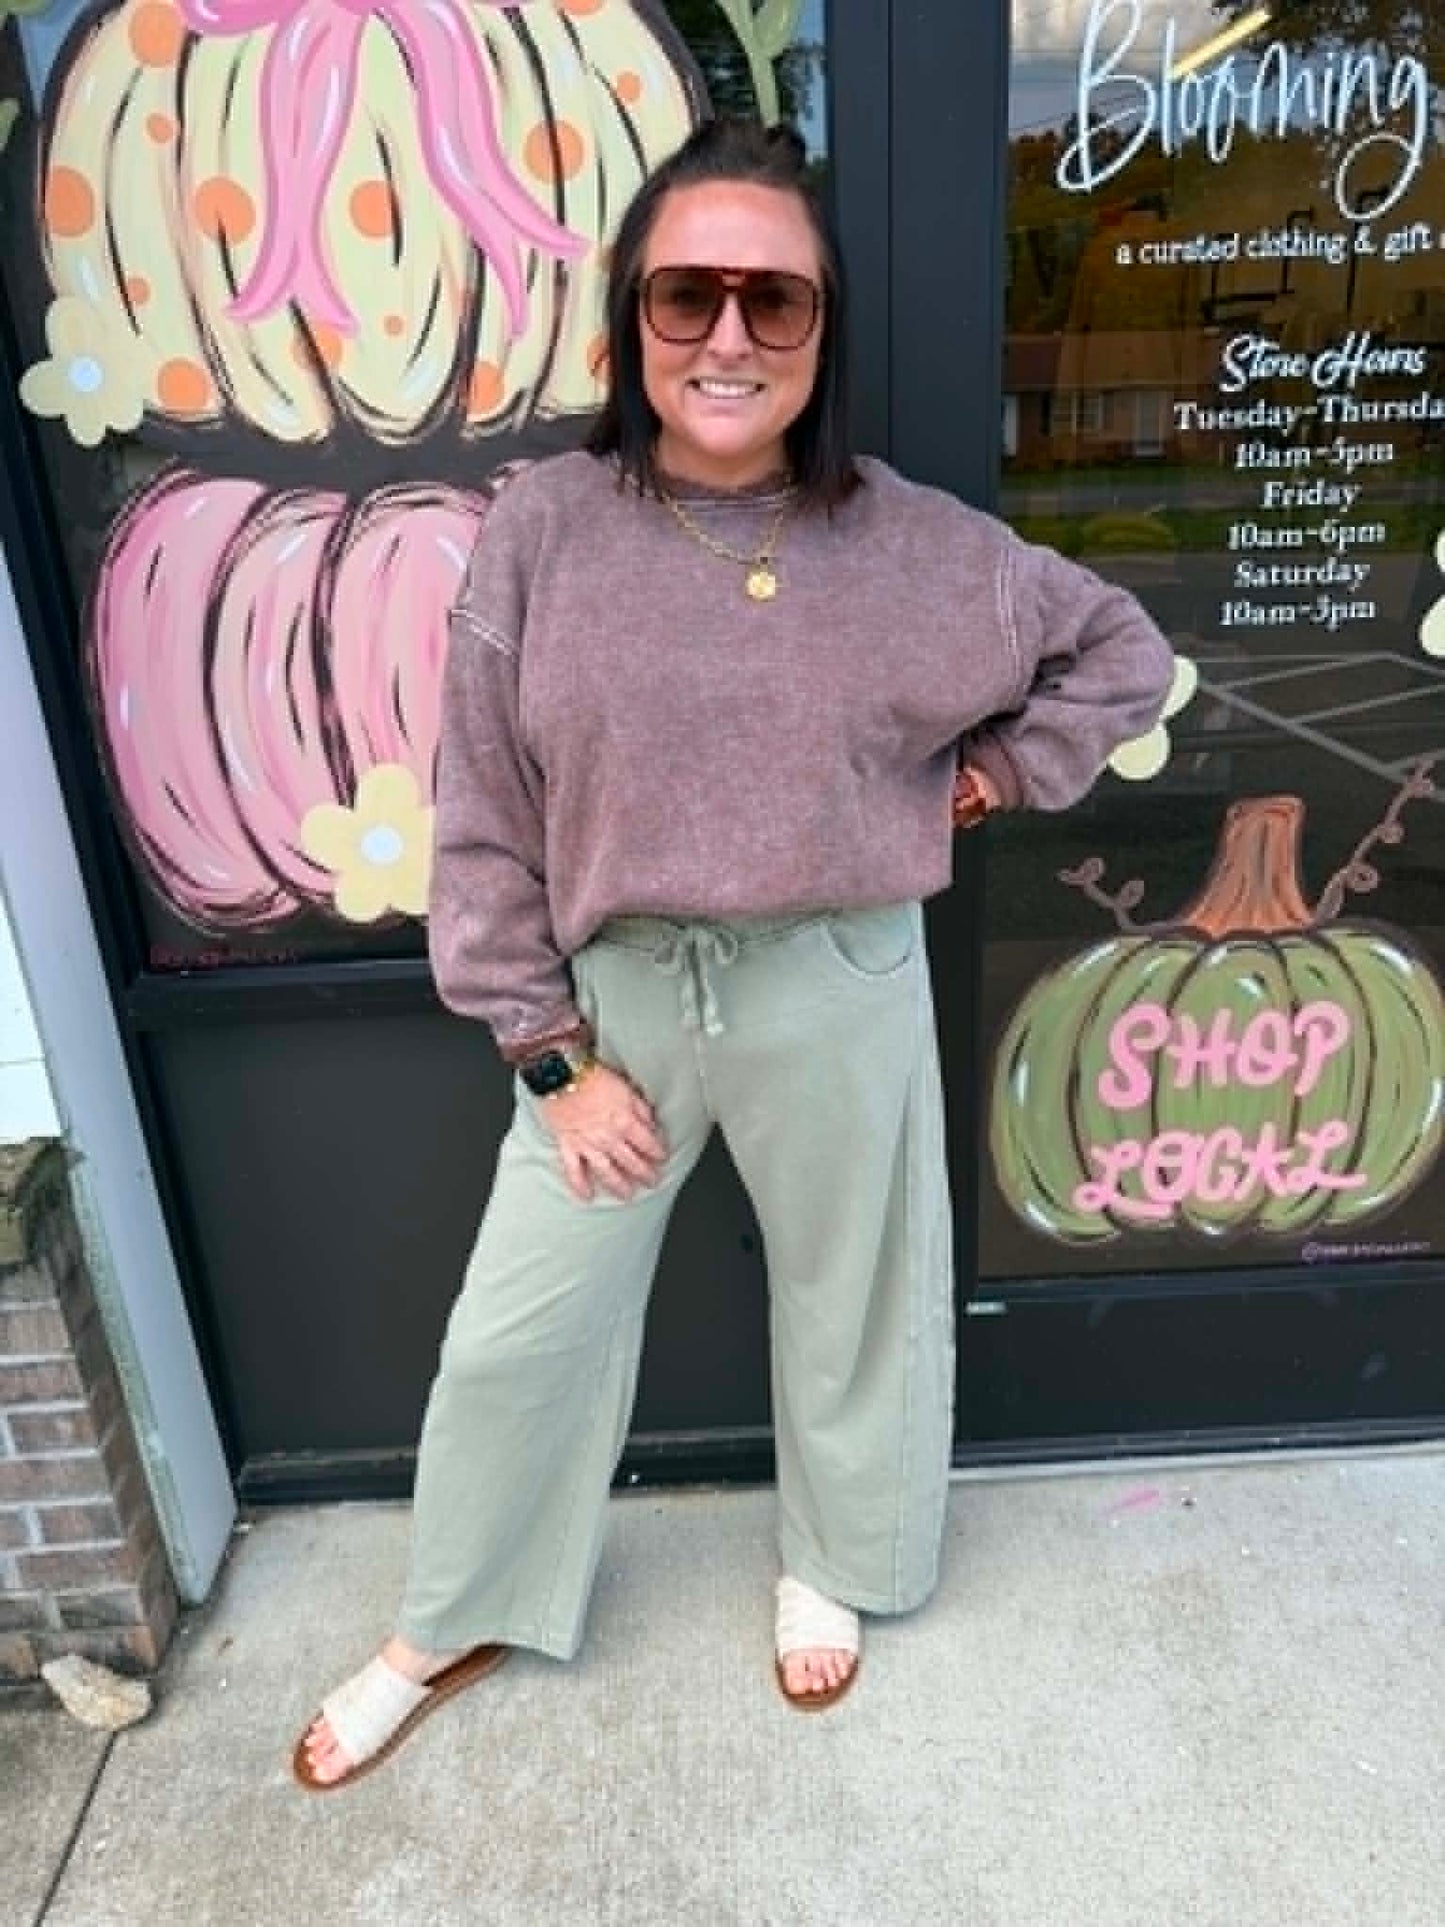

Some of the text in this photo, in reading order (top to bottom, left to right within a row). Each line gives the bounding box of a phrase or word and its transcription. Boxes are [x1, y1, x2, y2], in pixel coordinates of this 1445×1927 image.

[1056, 0, 1428, 220] Blooming
[1115, 243, 1133, 265] a
[1138, 234, 1241, 265] curated
[1246, 229, 1347, 264] clothing
[1354, 225, 1378, 255] &
[1384, 221, 1432, 262] gift
[1219, 331, 1428, 392] Store Hours
[1235, 437, 1394, 474] 10am-5pm
[1262, 478, 1362, 512] Friday
[1227, 519, 1386, 556] 10am-6pm
[1234, 557, 1371, 594] Saturday
[1099, 1002, 1350, 1109] SHOP
[1073, 1121, 1368, 1219] LOCAL
